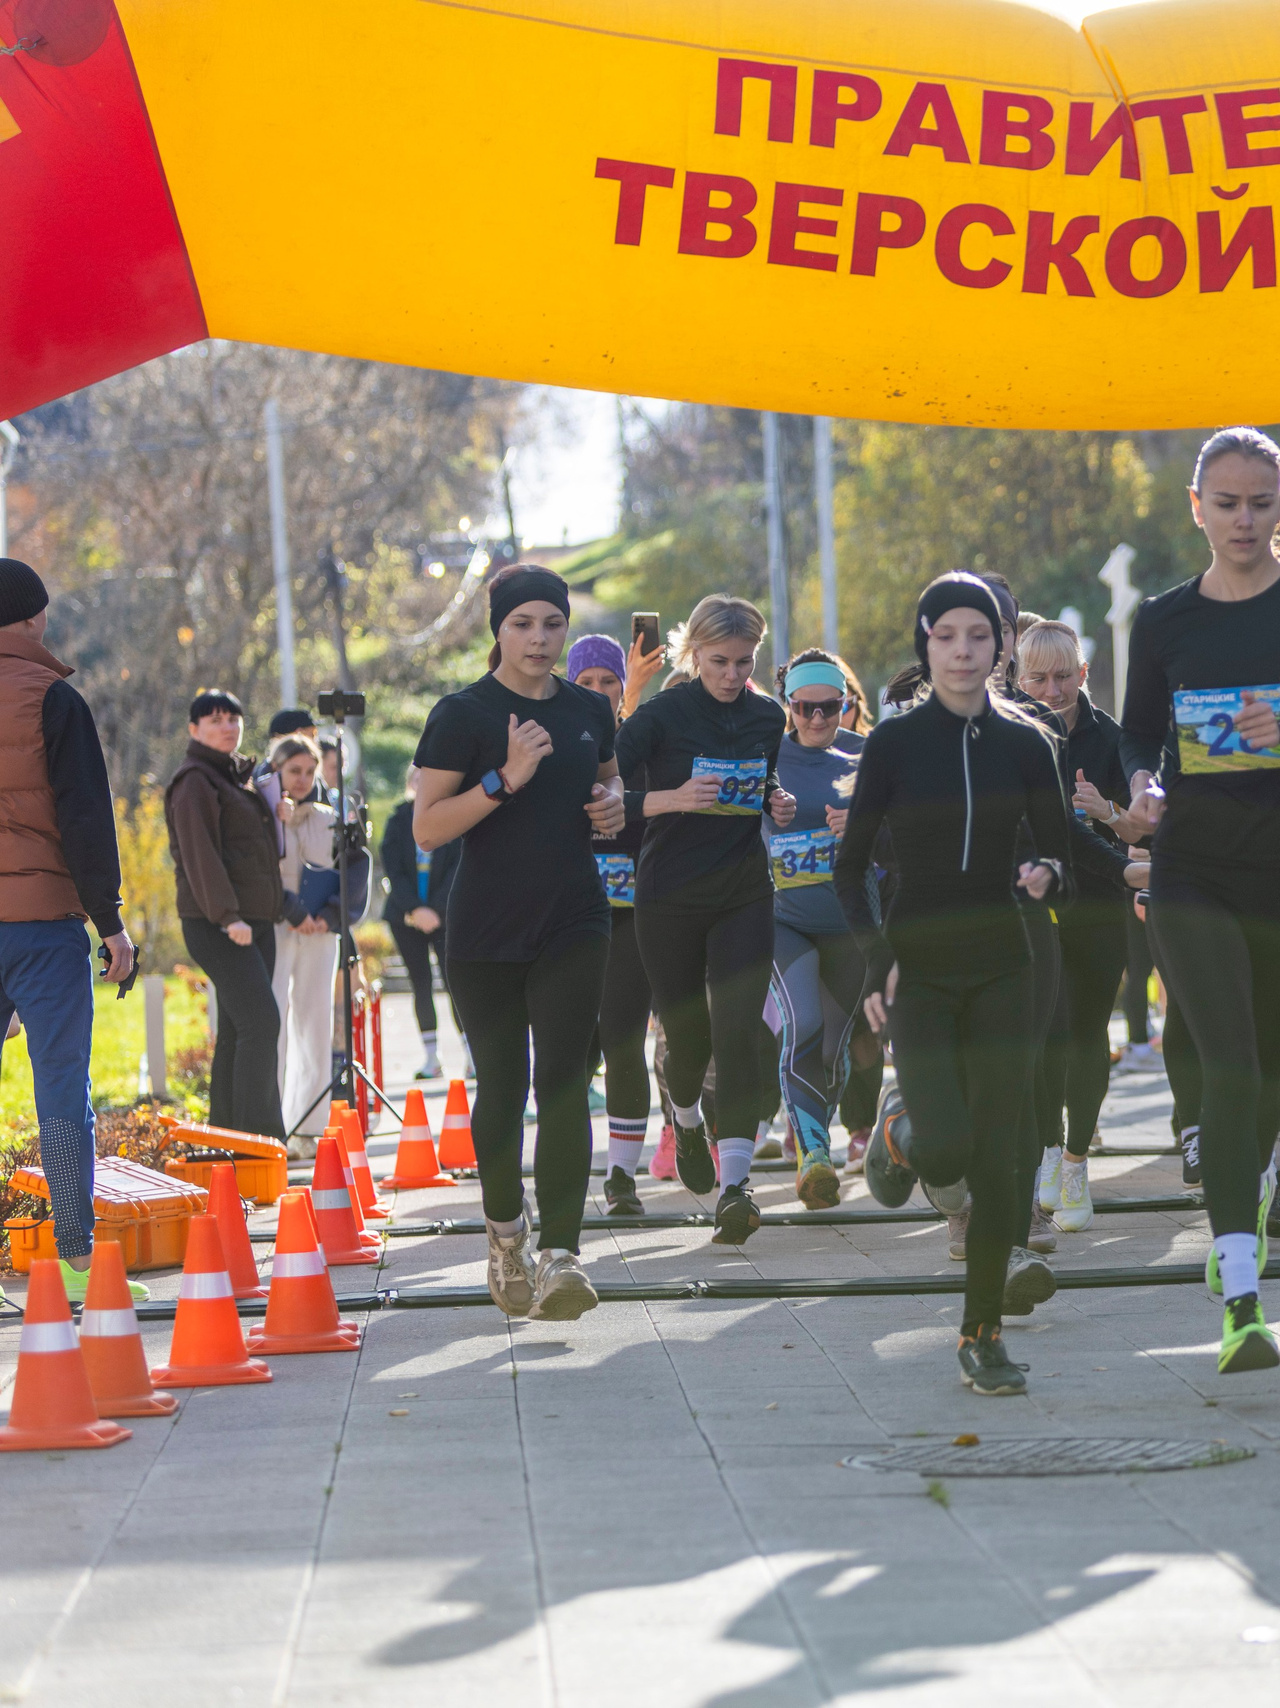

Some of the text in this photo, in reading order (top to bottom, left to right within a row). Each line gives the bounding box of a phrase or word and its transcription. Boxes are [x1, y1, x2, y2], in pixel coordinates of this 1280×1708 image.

[594, 156, 1278, 299] ТВЕРСКОЙ
[1182, 693, 1236, 704] СТАРИЦКИЕ
[717, 775, 759, 805] 92
[781, 841, 836, 878] 341
